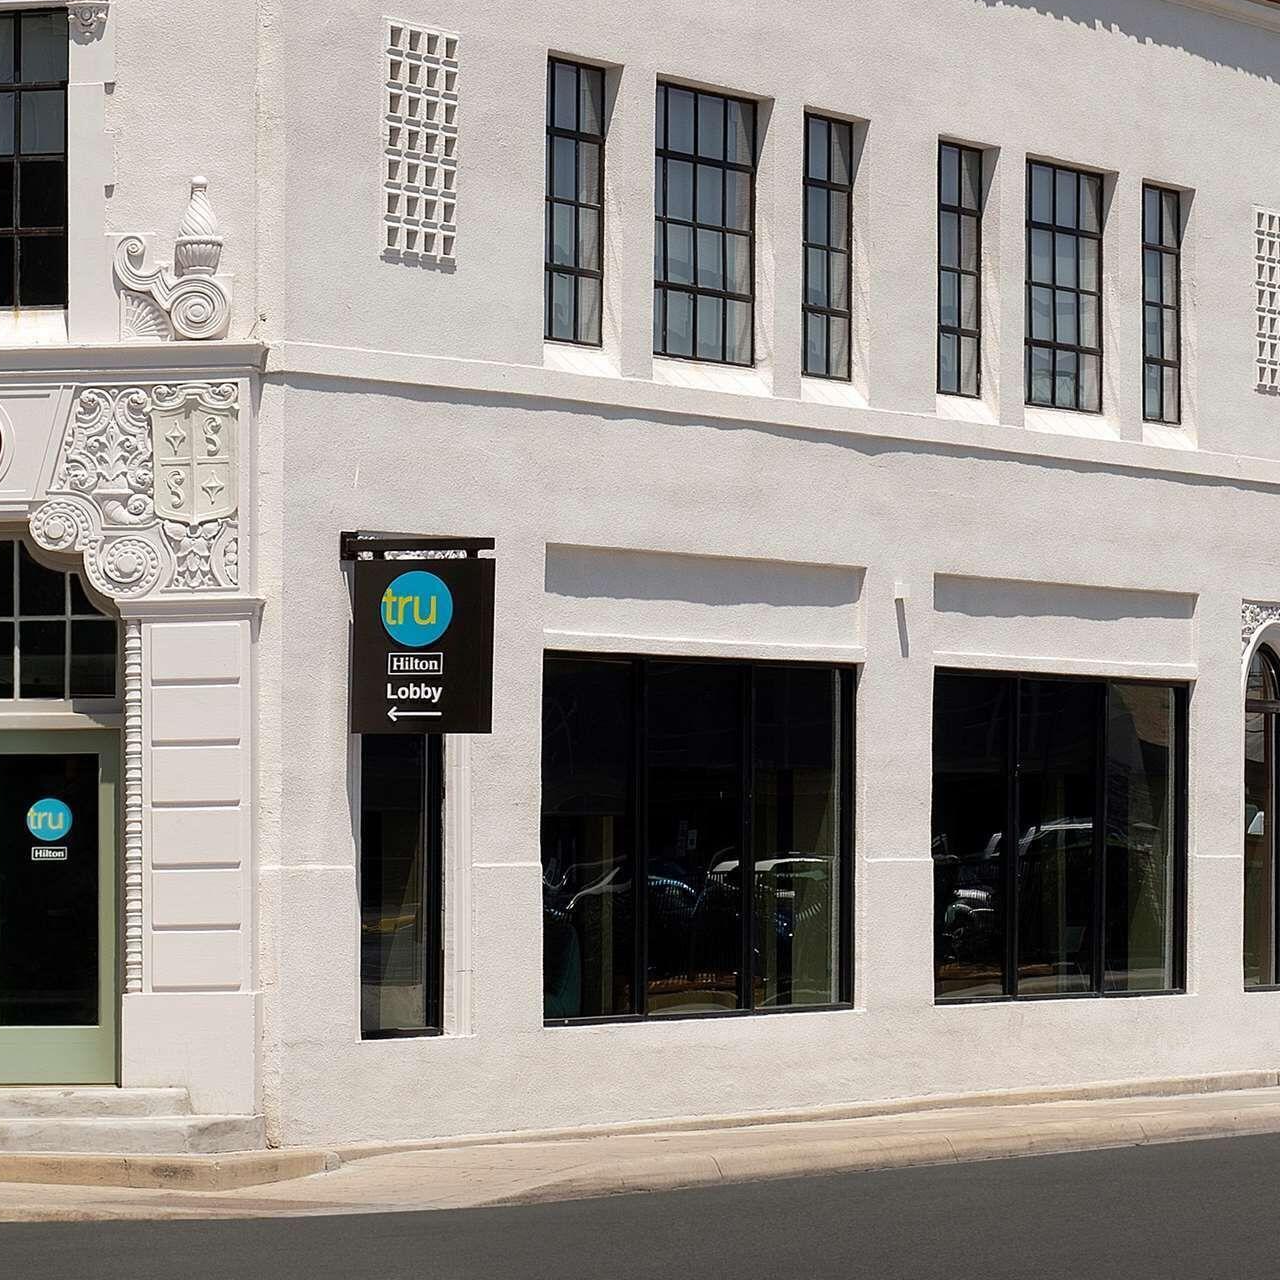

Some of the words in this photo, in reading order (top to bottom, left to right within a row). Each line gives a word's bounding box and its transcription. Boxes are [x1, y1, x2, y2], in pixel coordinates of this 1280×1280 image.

[382, 588, 437, 625] tru
[392, 656, 439, 671] Hilton
[386, 683, 443, 703] Lobby
[27, 808, 64, 830] tru
[34, 849, 65, 858] Hilton
